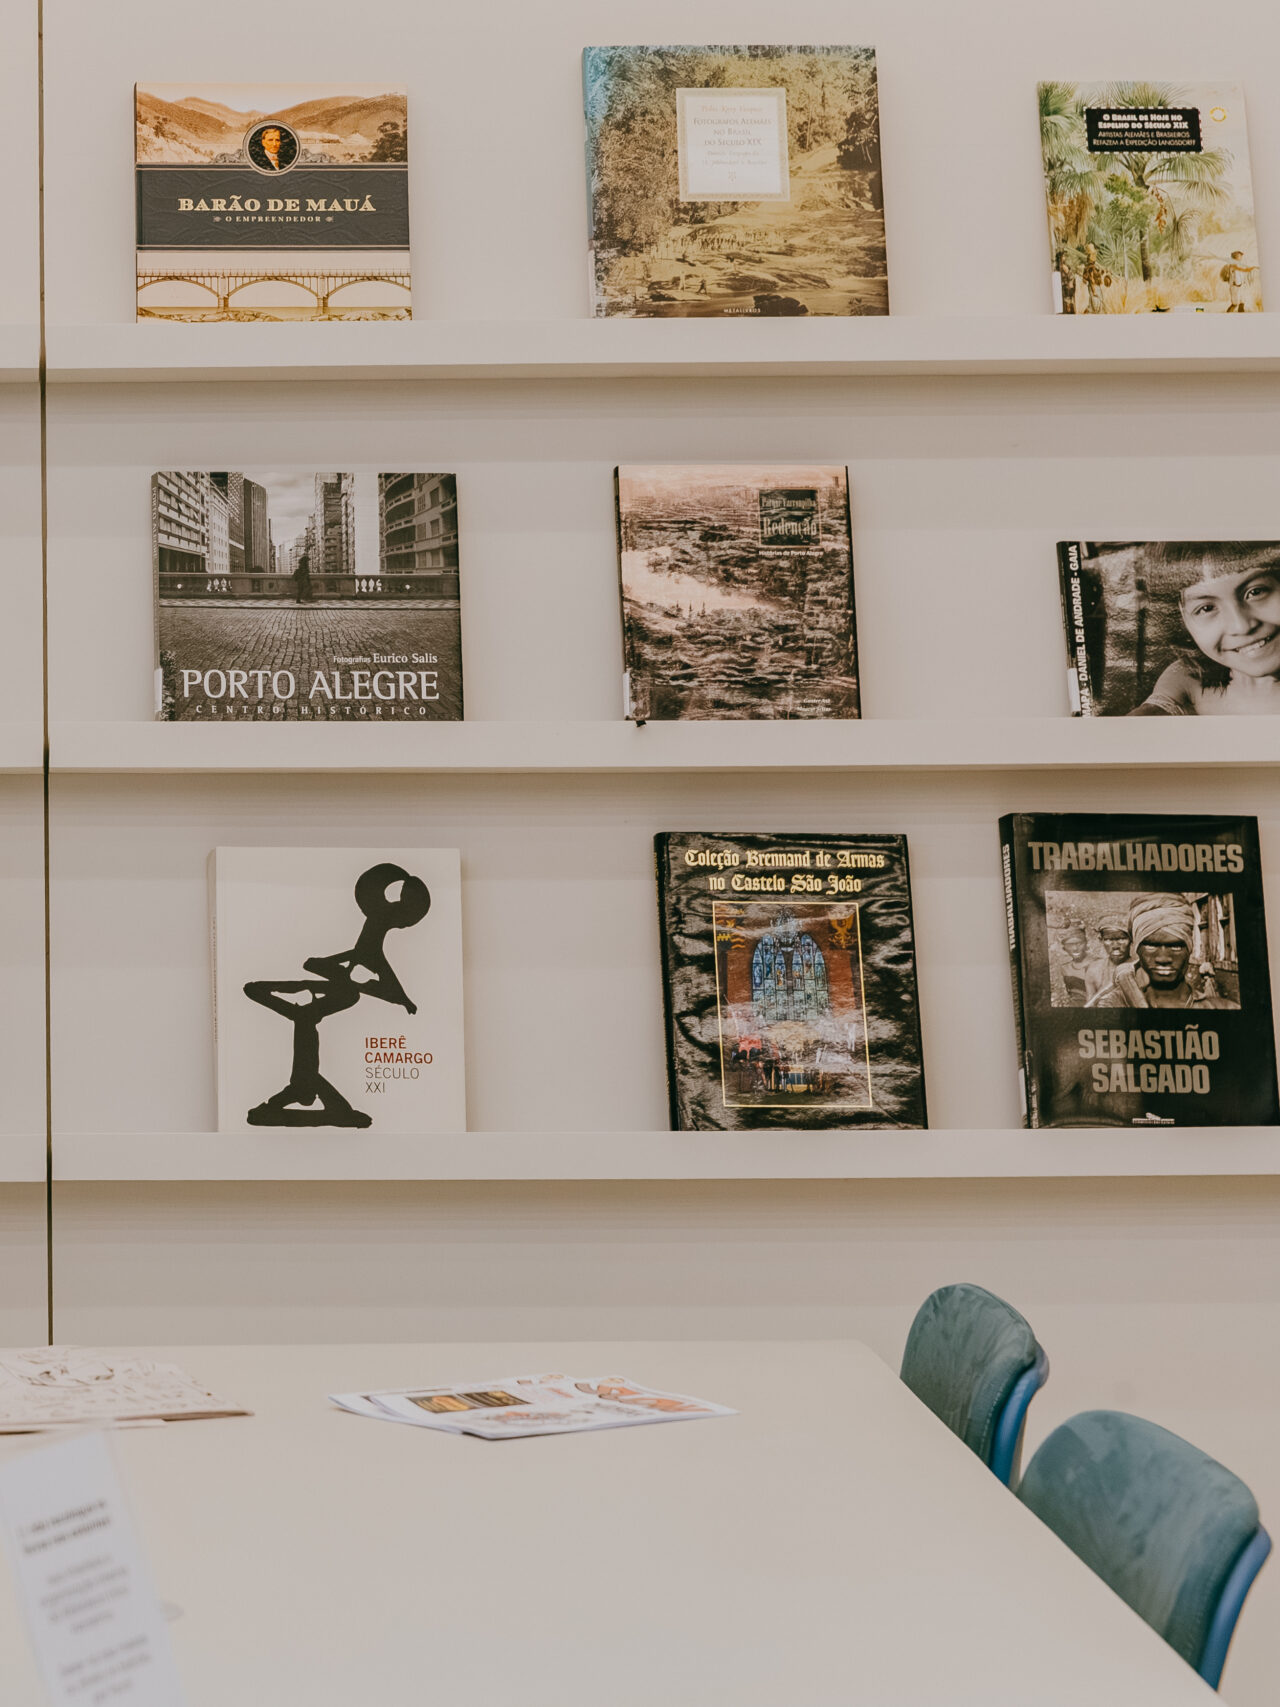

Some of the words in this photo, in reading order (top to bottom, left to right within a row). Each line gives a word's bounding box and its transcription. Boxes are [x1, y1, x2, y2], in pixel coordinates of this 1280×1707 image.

[1102, 113, 1110, 121] O
[1173, 121, 1189, 129] XIX
[177, 194, 262, 212] BARÃO
[267, 198, 300, 212] DE
[306, 194, 377, 212] MAUÁ
[225, 215, 233, 223] O
[236, 215, 322, 223] EMPREENDEDOR
[763, 516, 817, 539] Redenção
[1068, 544, 1080, 571] GAIA
[1070, 577, 1084, 627] ANDRADE
[1074, 628, 1086, 643] DE
[333, 655, 371, 665] Fotografias
[373, 652, 408, 664] Eurico
[411, 652, 438, 664] Salis
[1076, 644, 1089, 681] DANIEL
[180, 669, 296, 699] PORTO
[308, 670, 440, 700] ALEGRE
[195, 705, 281, 715] CENTRO
[301, 703, 427, 716] HISTÓRICO
[684, 849, 740, 870] Coleção
[745, 850, 811, 868] Brennand
[815, 850, 832, 868] de
[835, 851, 885, 868] Armas
[1027, 841, 1244, 873] TRABALHADORES
[708, 874, 726, 891] no
[730, 873, 786, 892] Castelo
[790, 873, 822, 894] São
[825, 874, 862, 895] João
[1003, 842, 1016, 951] TRABALHADORES
[365, 1035, 407, 1050] IBERÊ
[1077, 1023, 1220, 1061] SEBASTIÃO
[364, 1051, 433, 1065] CAMARGO
[365, 1064, 420, 1080] SÉCULO
[1091, 1063, 1210, 1095] SALGADO
[365, 1081, 386, 1094] XXI
